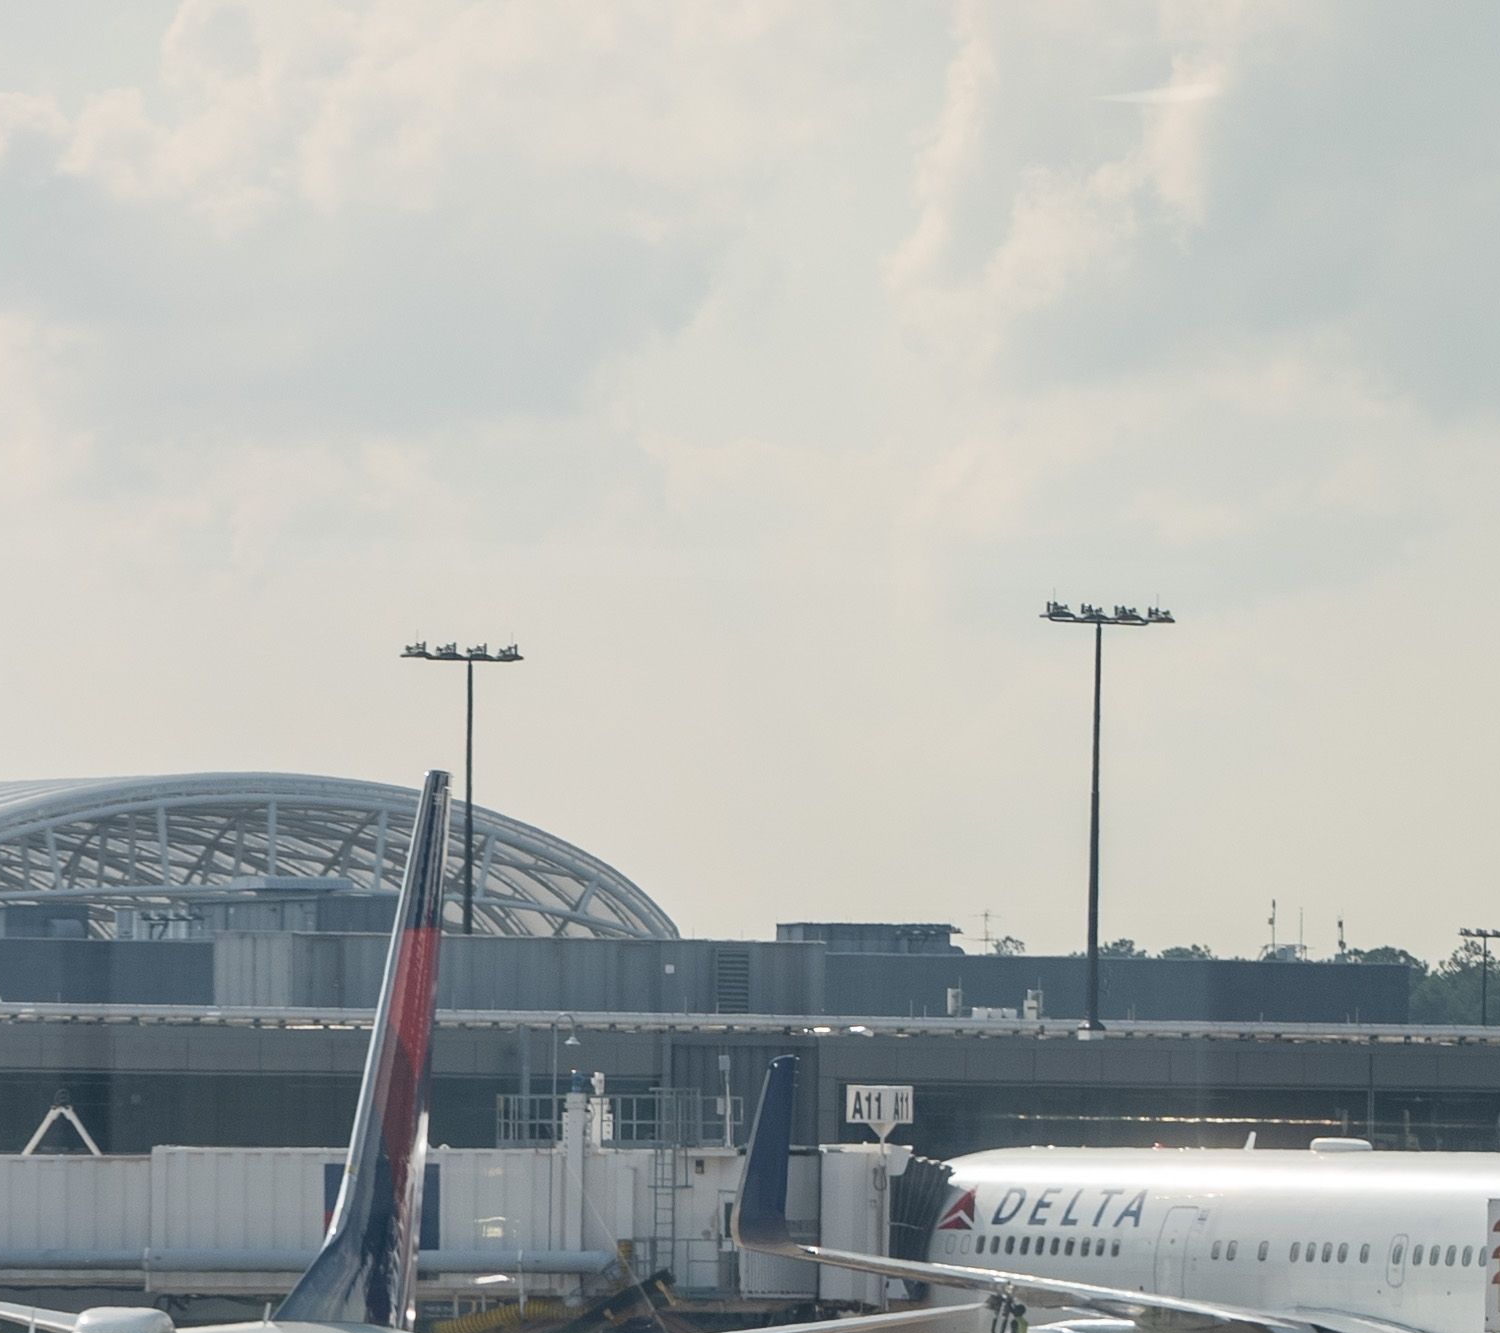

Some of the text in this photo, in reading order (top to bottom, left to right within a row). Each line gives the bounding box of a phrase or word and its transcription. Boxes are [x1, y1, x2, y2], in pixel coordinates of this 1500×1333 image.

[852, 1091, 882, 1120] A11
[893, 1092, 909, 1120] A11
[991, 1187, 1149, 1227] DELTA
